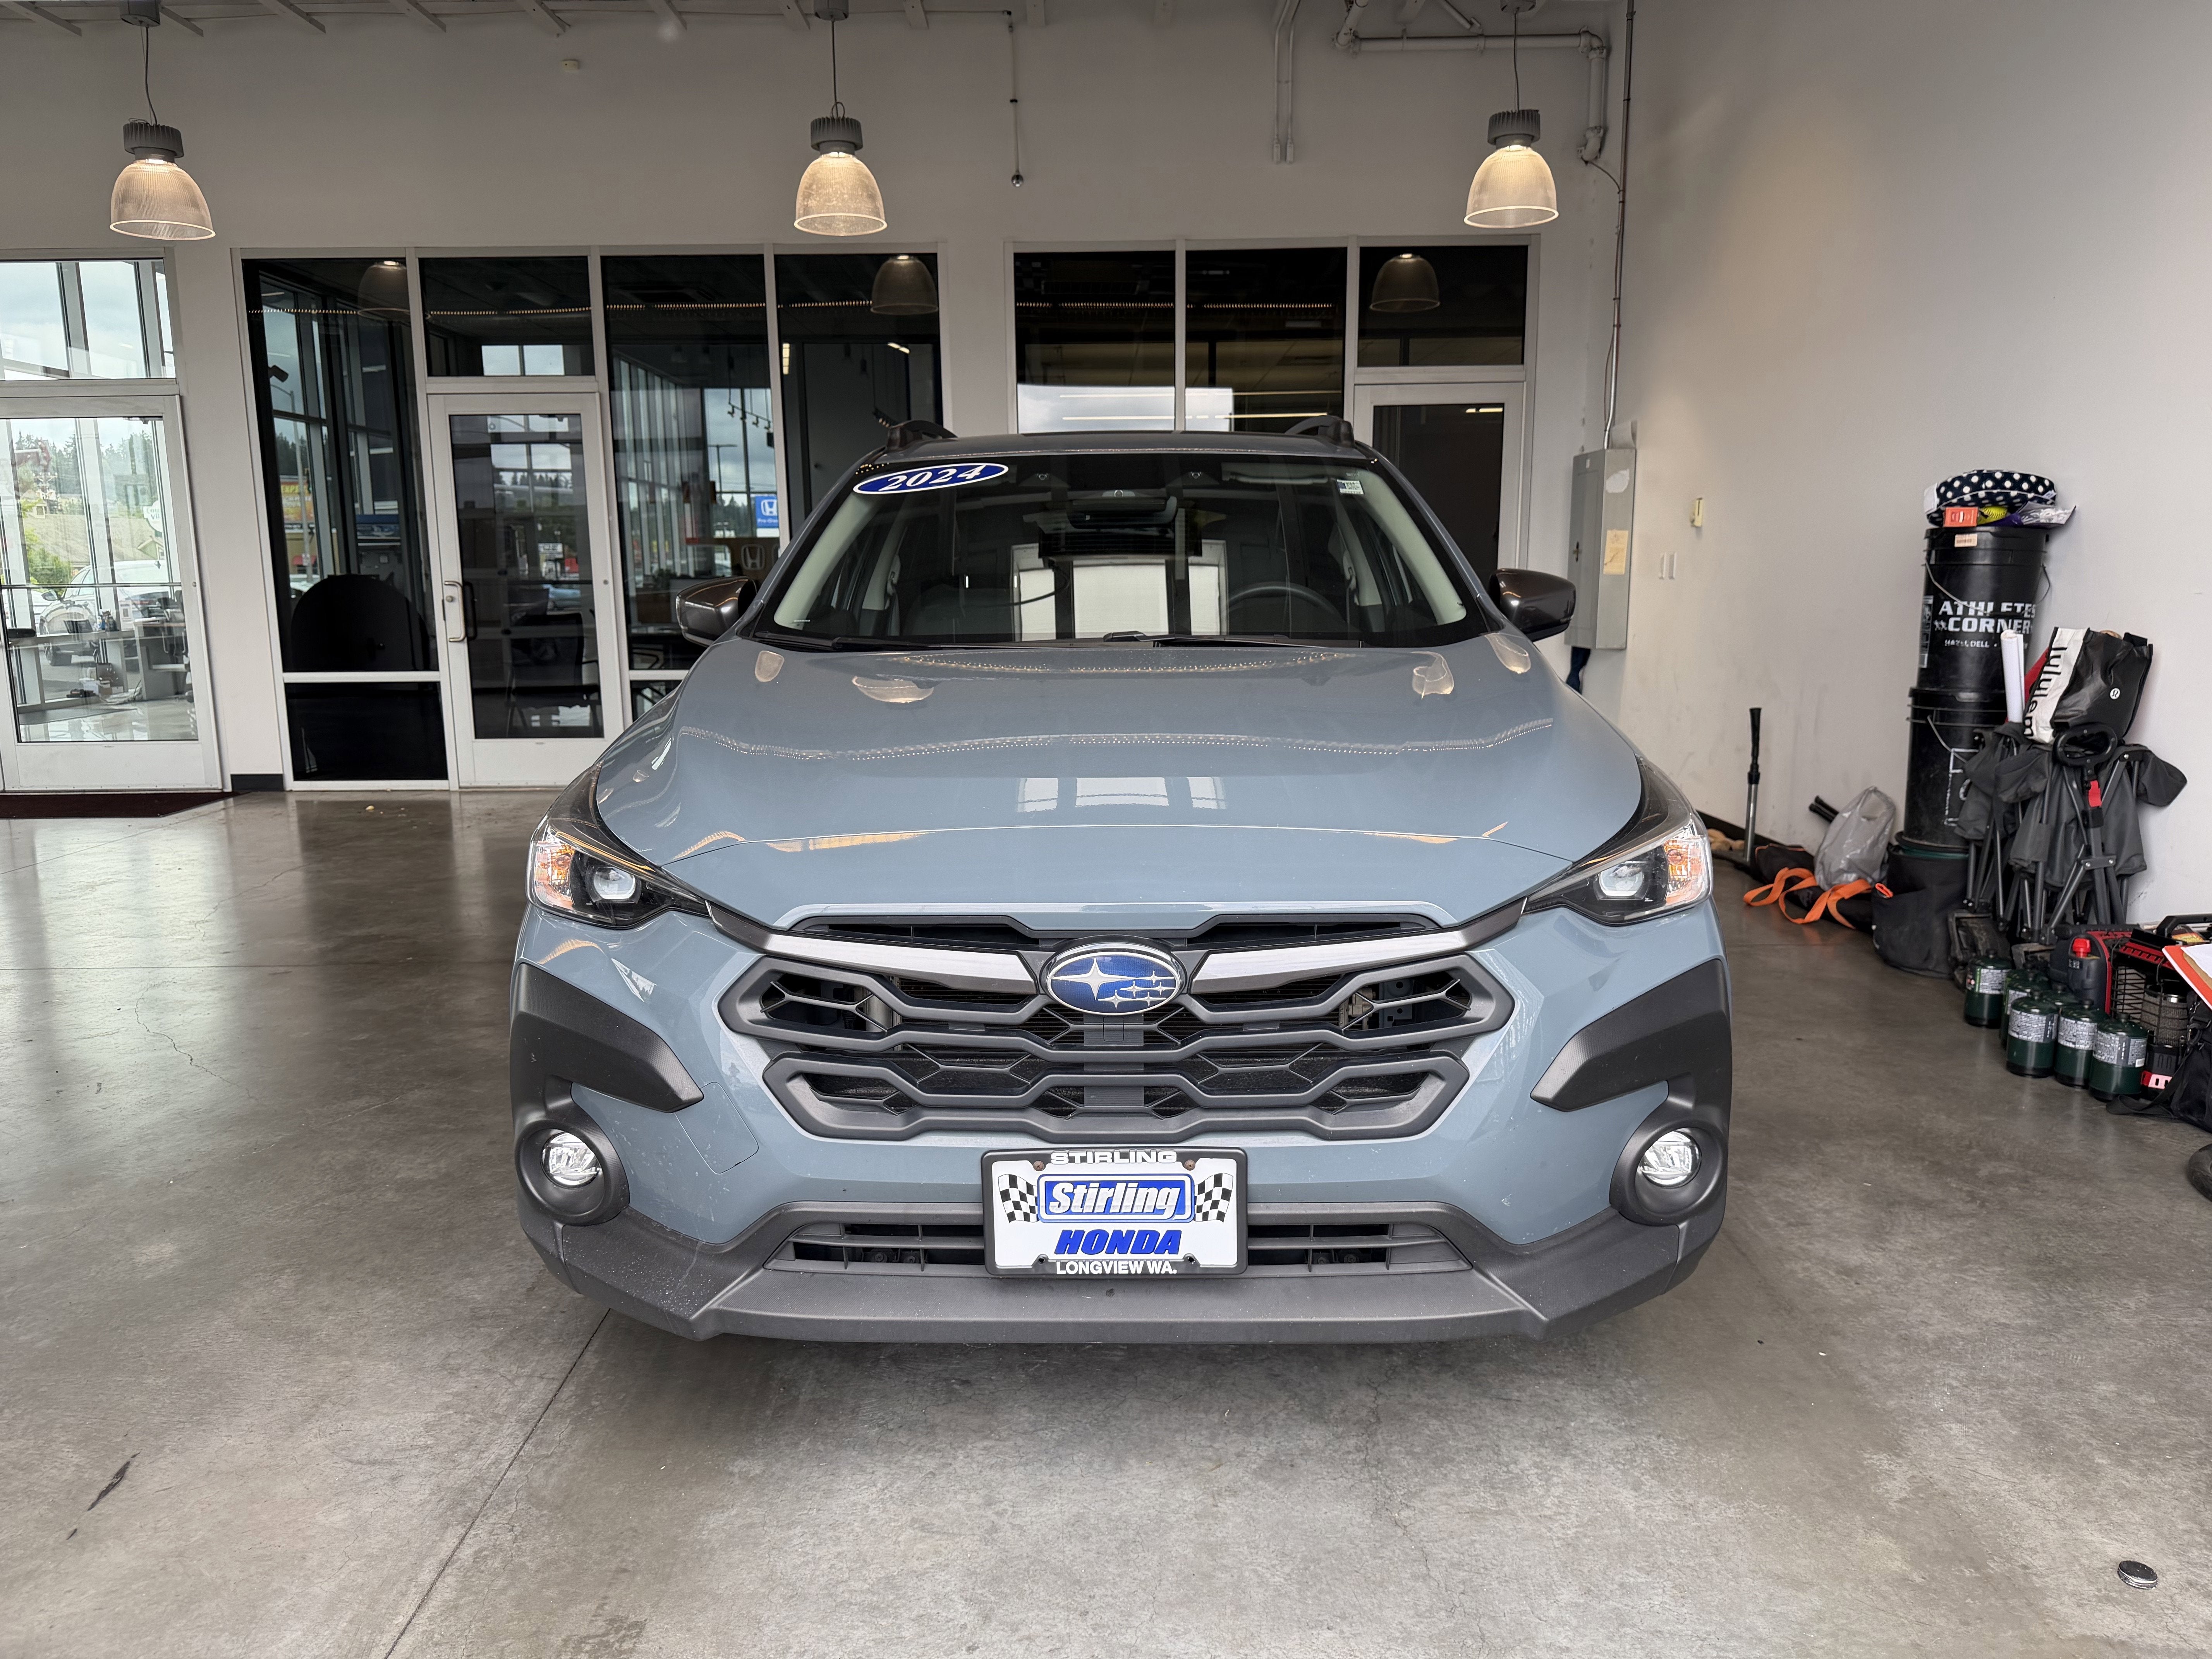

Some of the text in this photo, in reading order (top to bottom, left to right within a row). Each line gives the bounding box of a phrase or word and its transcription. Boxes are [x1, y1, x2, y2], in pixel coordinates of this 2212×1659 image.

[878, 465, 987, 491] 2024
[1948, 617, 2031, 634] CORNER
[1050, 1150, 1178, 1164] STIRLING
[1049, 1182, 1181, 1219] Stirling
[1054, 1229, 1182, 1255] HONDA
[1056, 1261, 1177, 1274] LONGVIEW WA.
